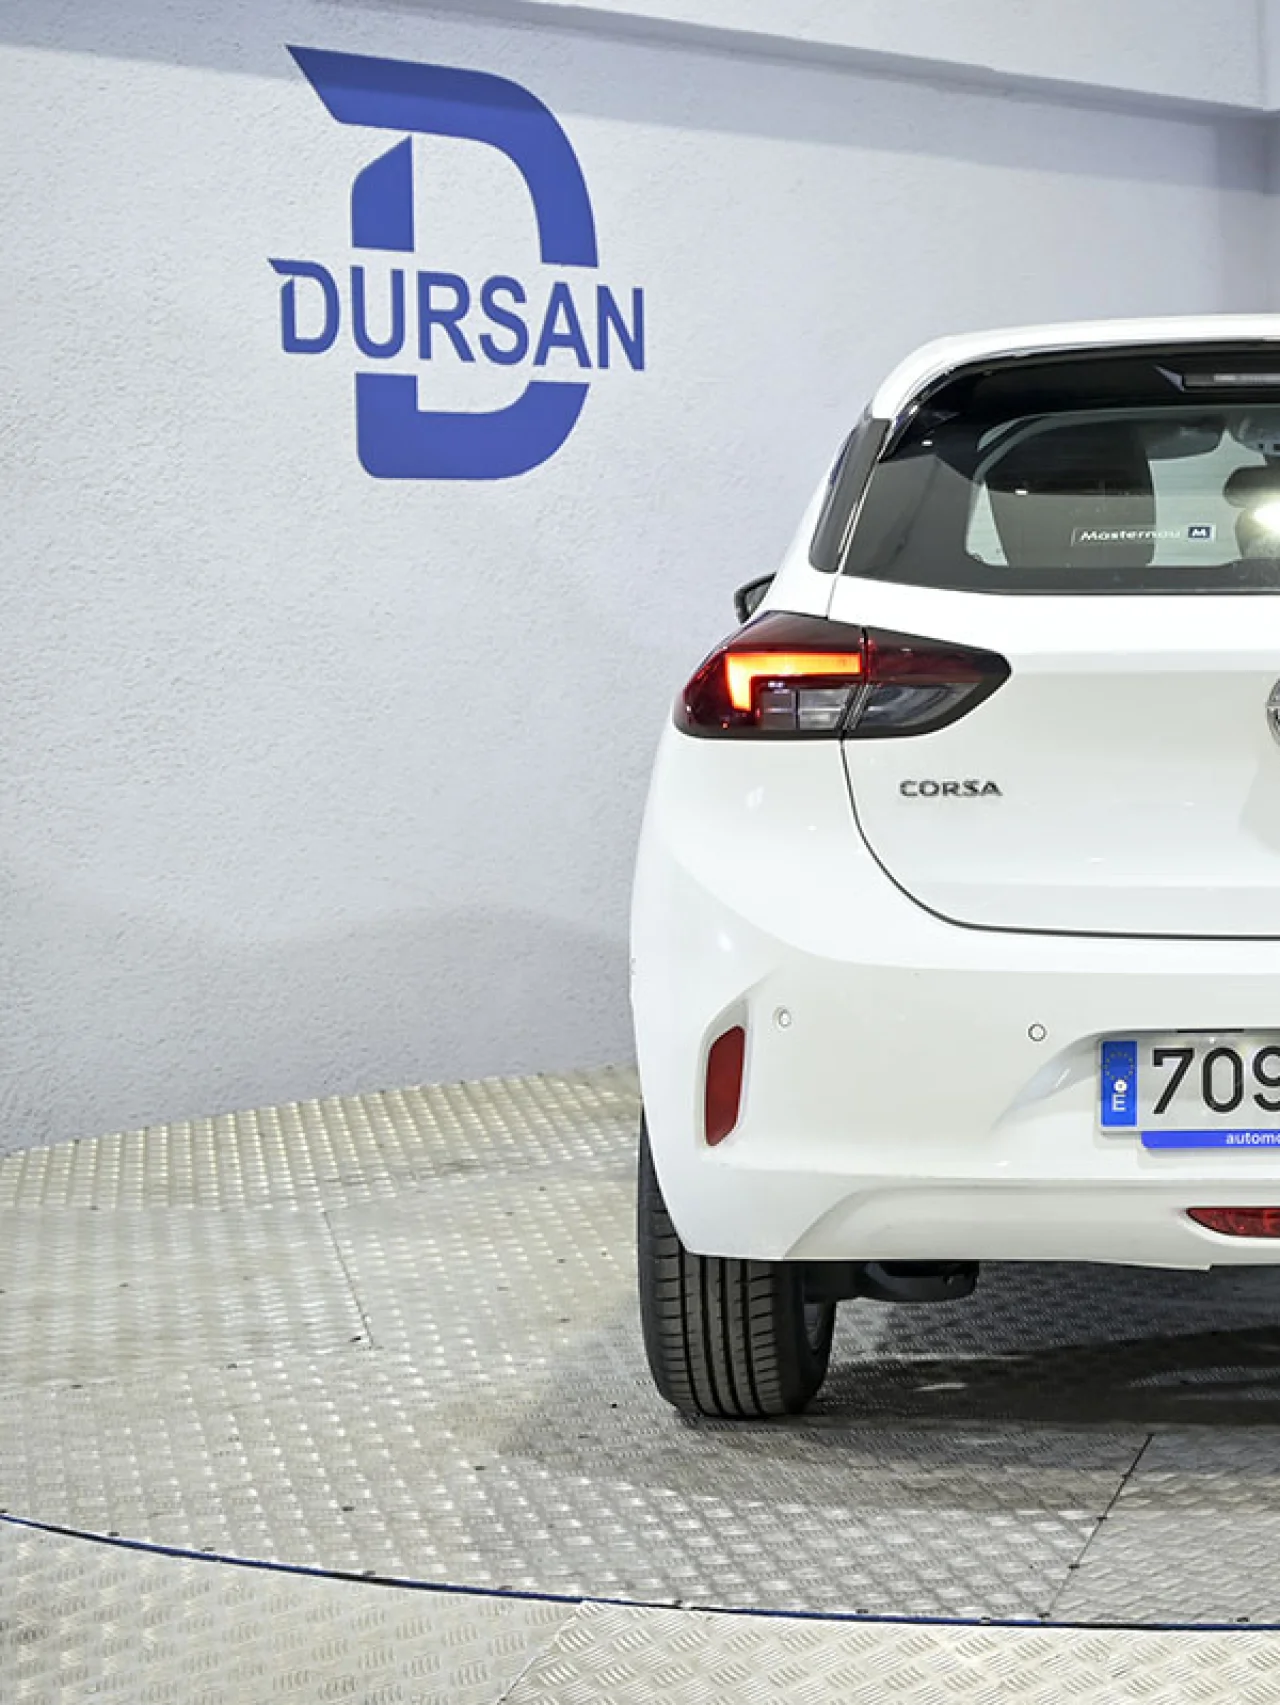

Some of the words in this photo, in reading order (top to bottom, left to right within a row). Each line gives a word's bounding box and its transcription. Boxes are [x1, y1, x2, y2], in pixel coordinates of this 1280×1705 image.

[267, 257, 645, 372] DURSAN
[899, 779, 1004, 797] CORSA
[1112, 1093, 1127, 1113] E
